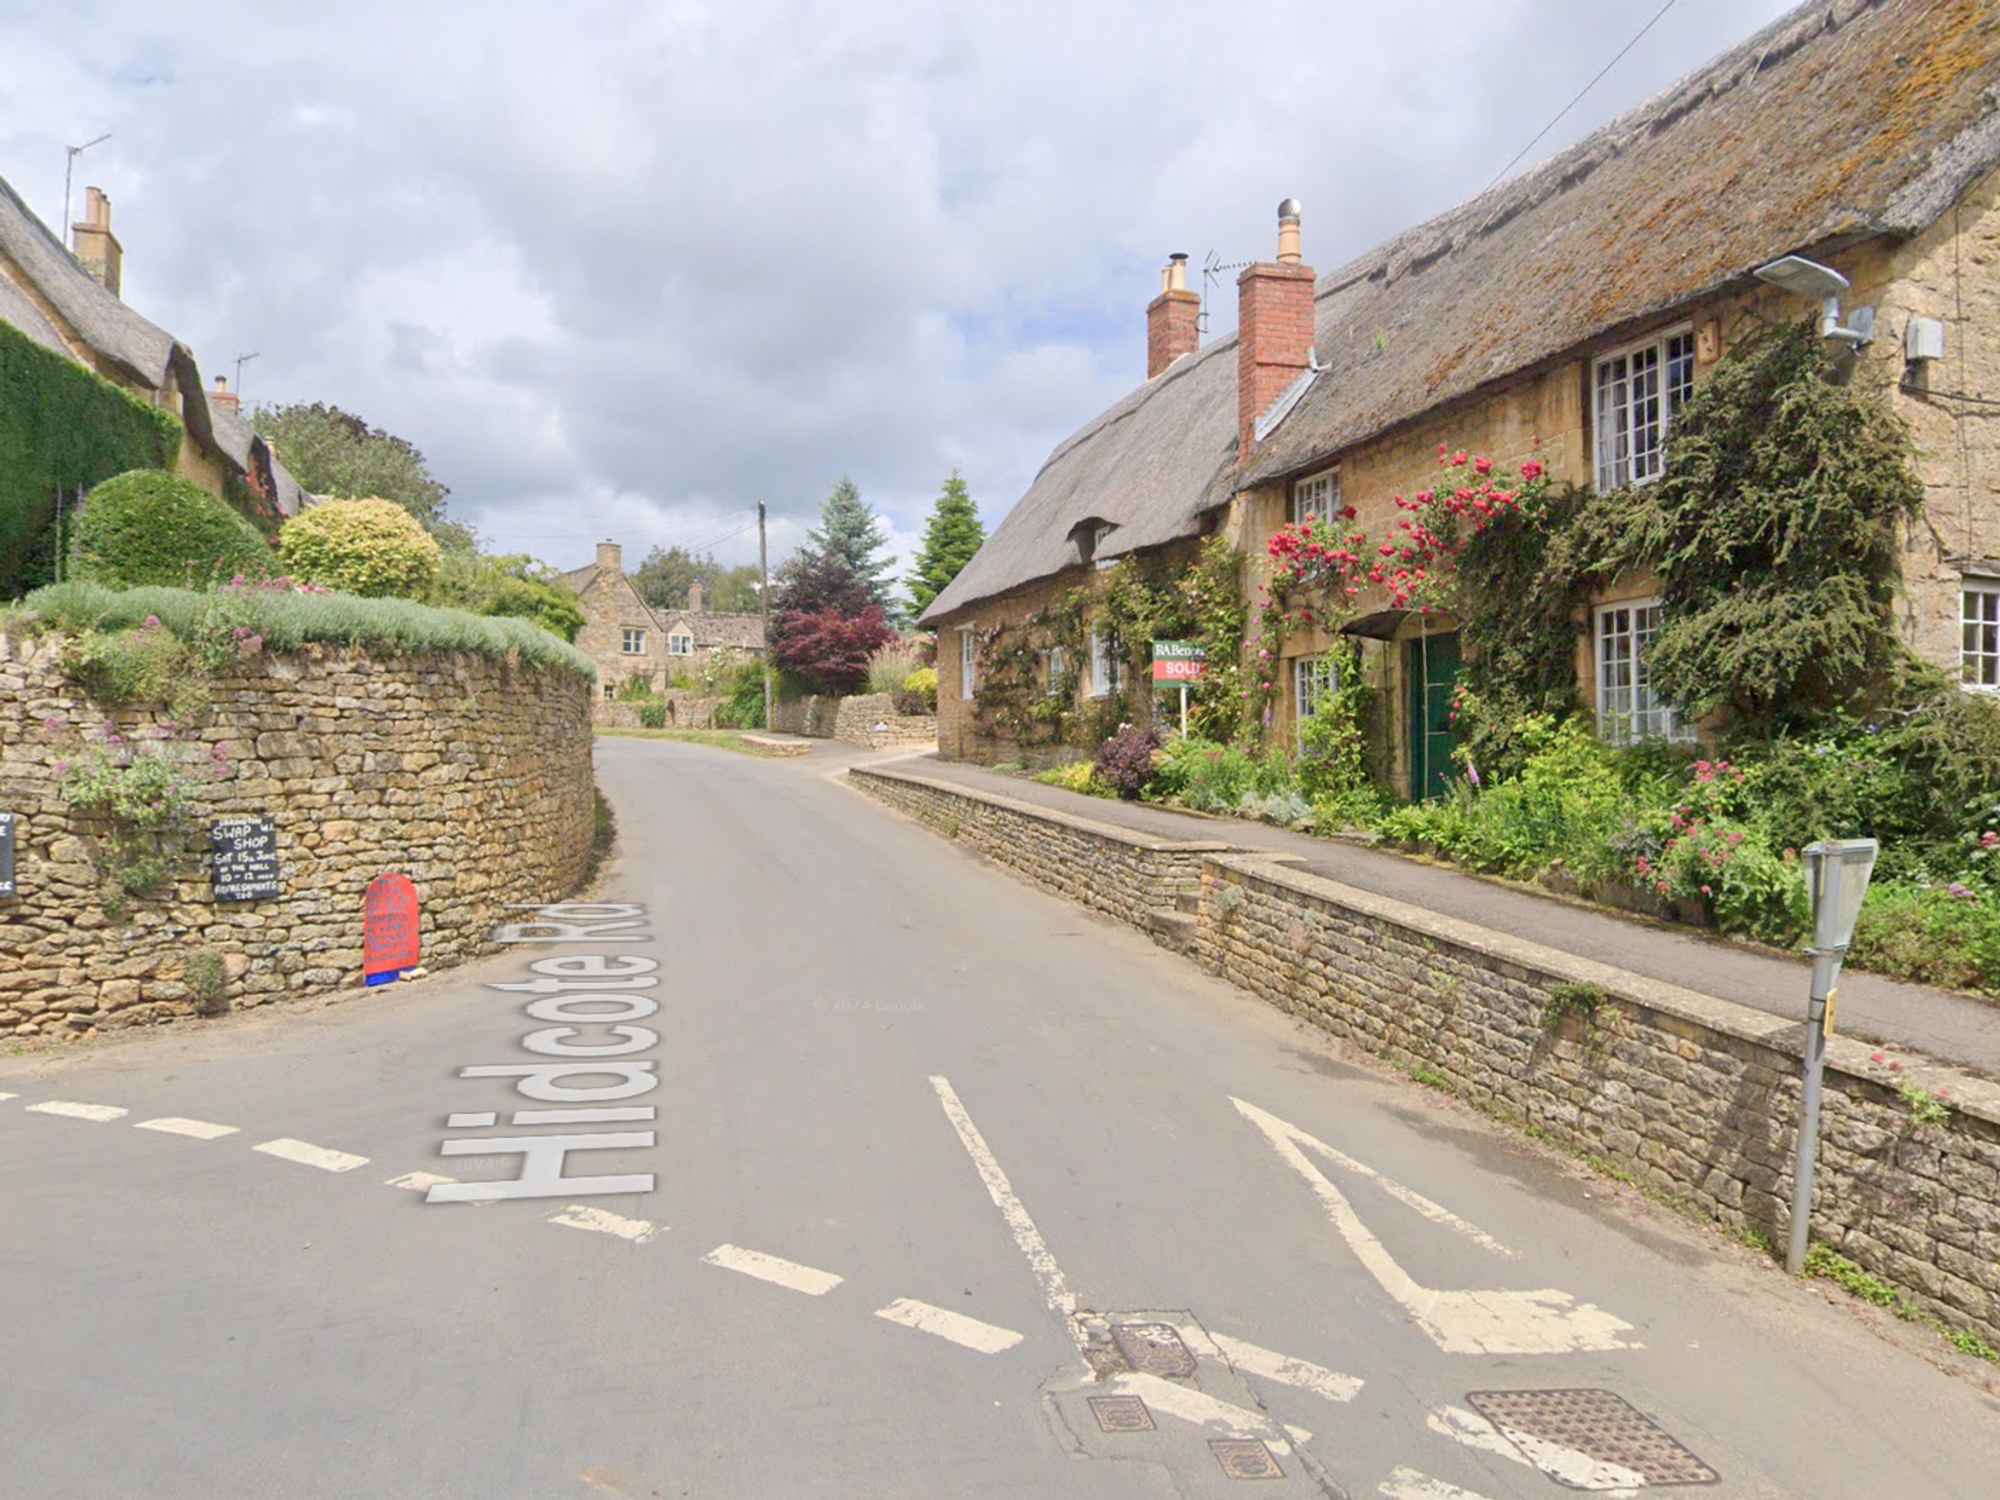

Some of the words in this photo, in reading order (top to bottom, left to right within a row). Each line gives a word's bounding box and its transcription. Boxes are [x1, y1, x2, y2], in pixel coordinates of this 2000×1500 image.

[1166, 662, 1200, 674] SOLD
[213, 825, 252, 840] SWAP
[233, 836, 268, 850] SHOP
[221, 873, 232, 883] 10
[244, 872, 254, 880] 12
